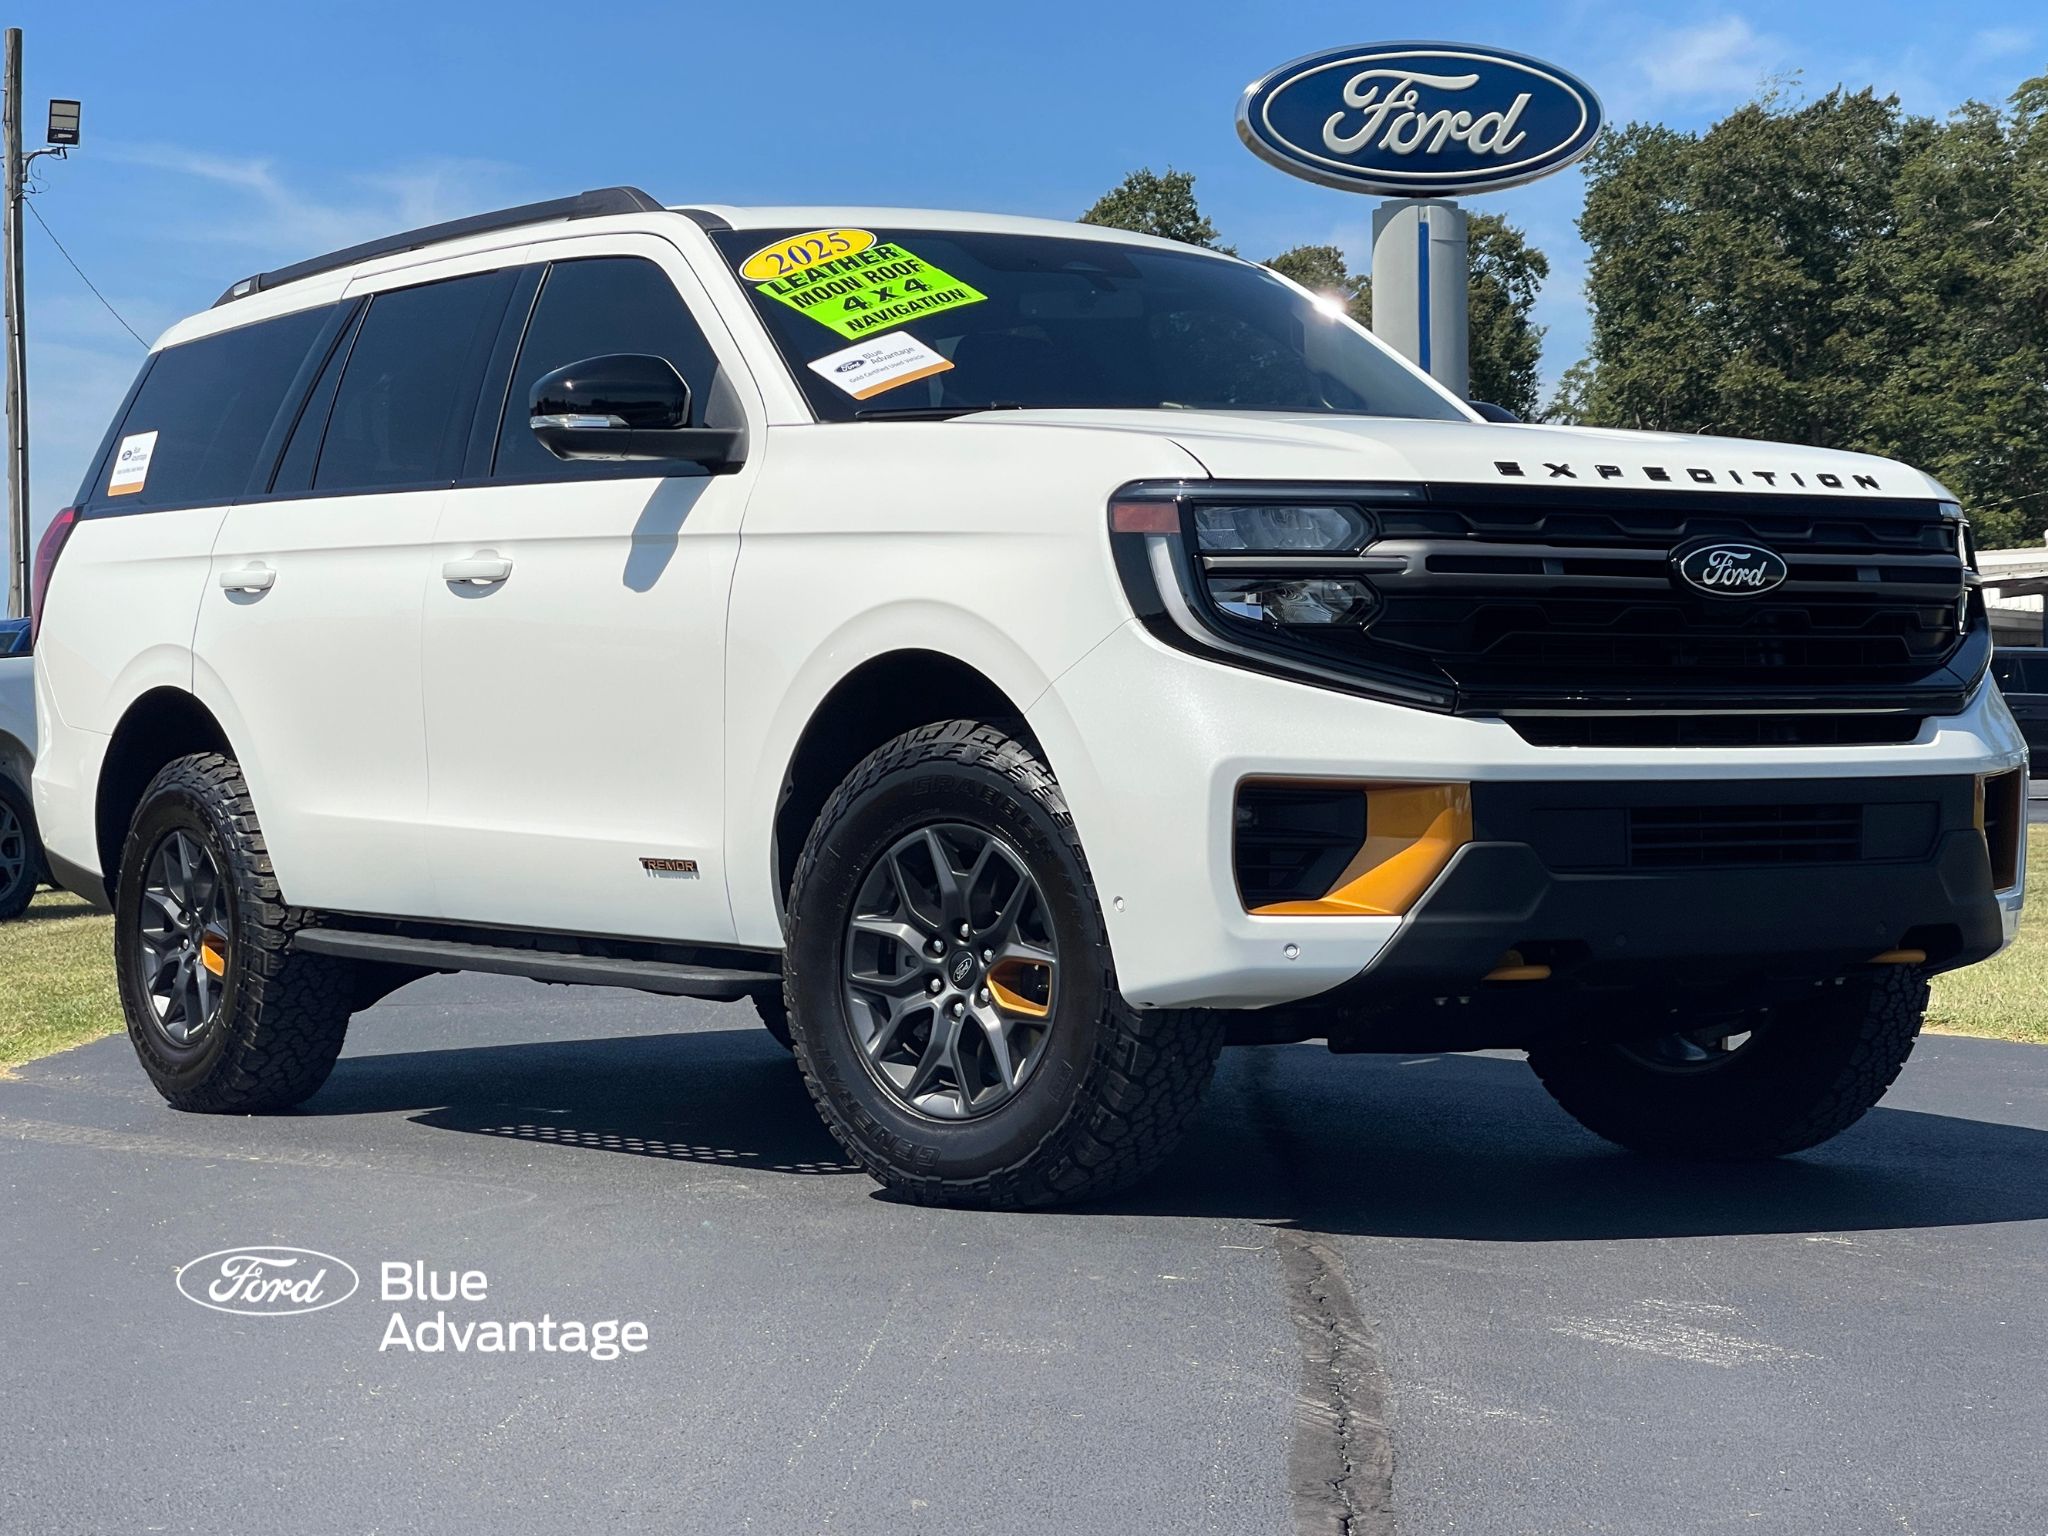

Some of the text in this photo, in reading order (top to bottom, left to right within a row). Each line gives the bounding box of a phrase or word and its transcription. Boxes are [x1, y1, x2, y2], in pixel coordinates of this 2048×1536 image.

[1322, 69, 1532, 154] Ford
[765, 232, 851, 275] 2025
[770, 246, 903, 295] LEATHER
[792, 259, 924, 308] MOON ROOF
[843, 296, 870, 312] 4
[902, 278, 934, 294] 4
[845, 289, 970, 332] NAVIGATION
[862, 350, 884, 360] Blue
[870, 346, 915, 365] Advantage
[1494, 461, 1882, 491] EXPEDITION
[1703, 551, 1767, 587] Ford
